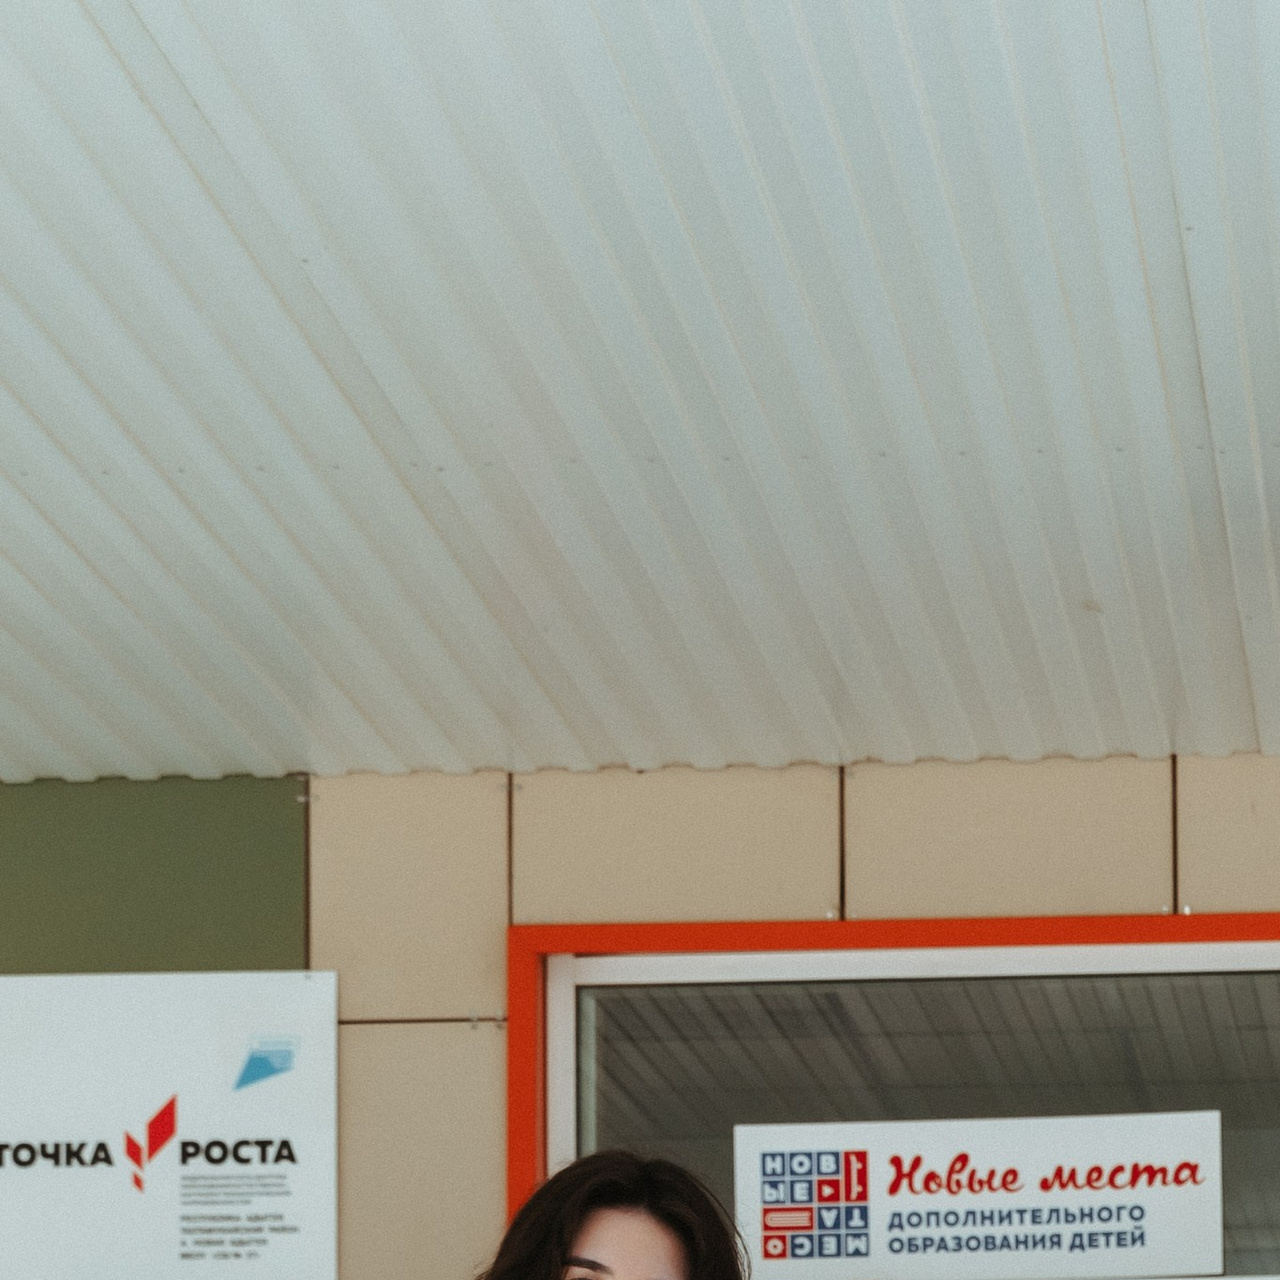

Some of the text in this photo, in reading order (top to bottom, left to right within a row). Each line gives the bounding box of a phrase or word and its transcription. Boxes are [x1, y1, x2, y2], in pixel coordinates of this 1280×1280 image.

[181, 1140, 296, 1165] РОСТА
[888, 1152, 1205, 1196] Новые места
[889, 1205, 1145, 1231] ДОПОЛНИТЕЛЬНОГО
[888, 1226, 1145, 1253] ОБРАЗОВАНИЯ ДЕТЕЙ
